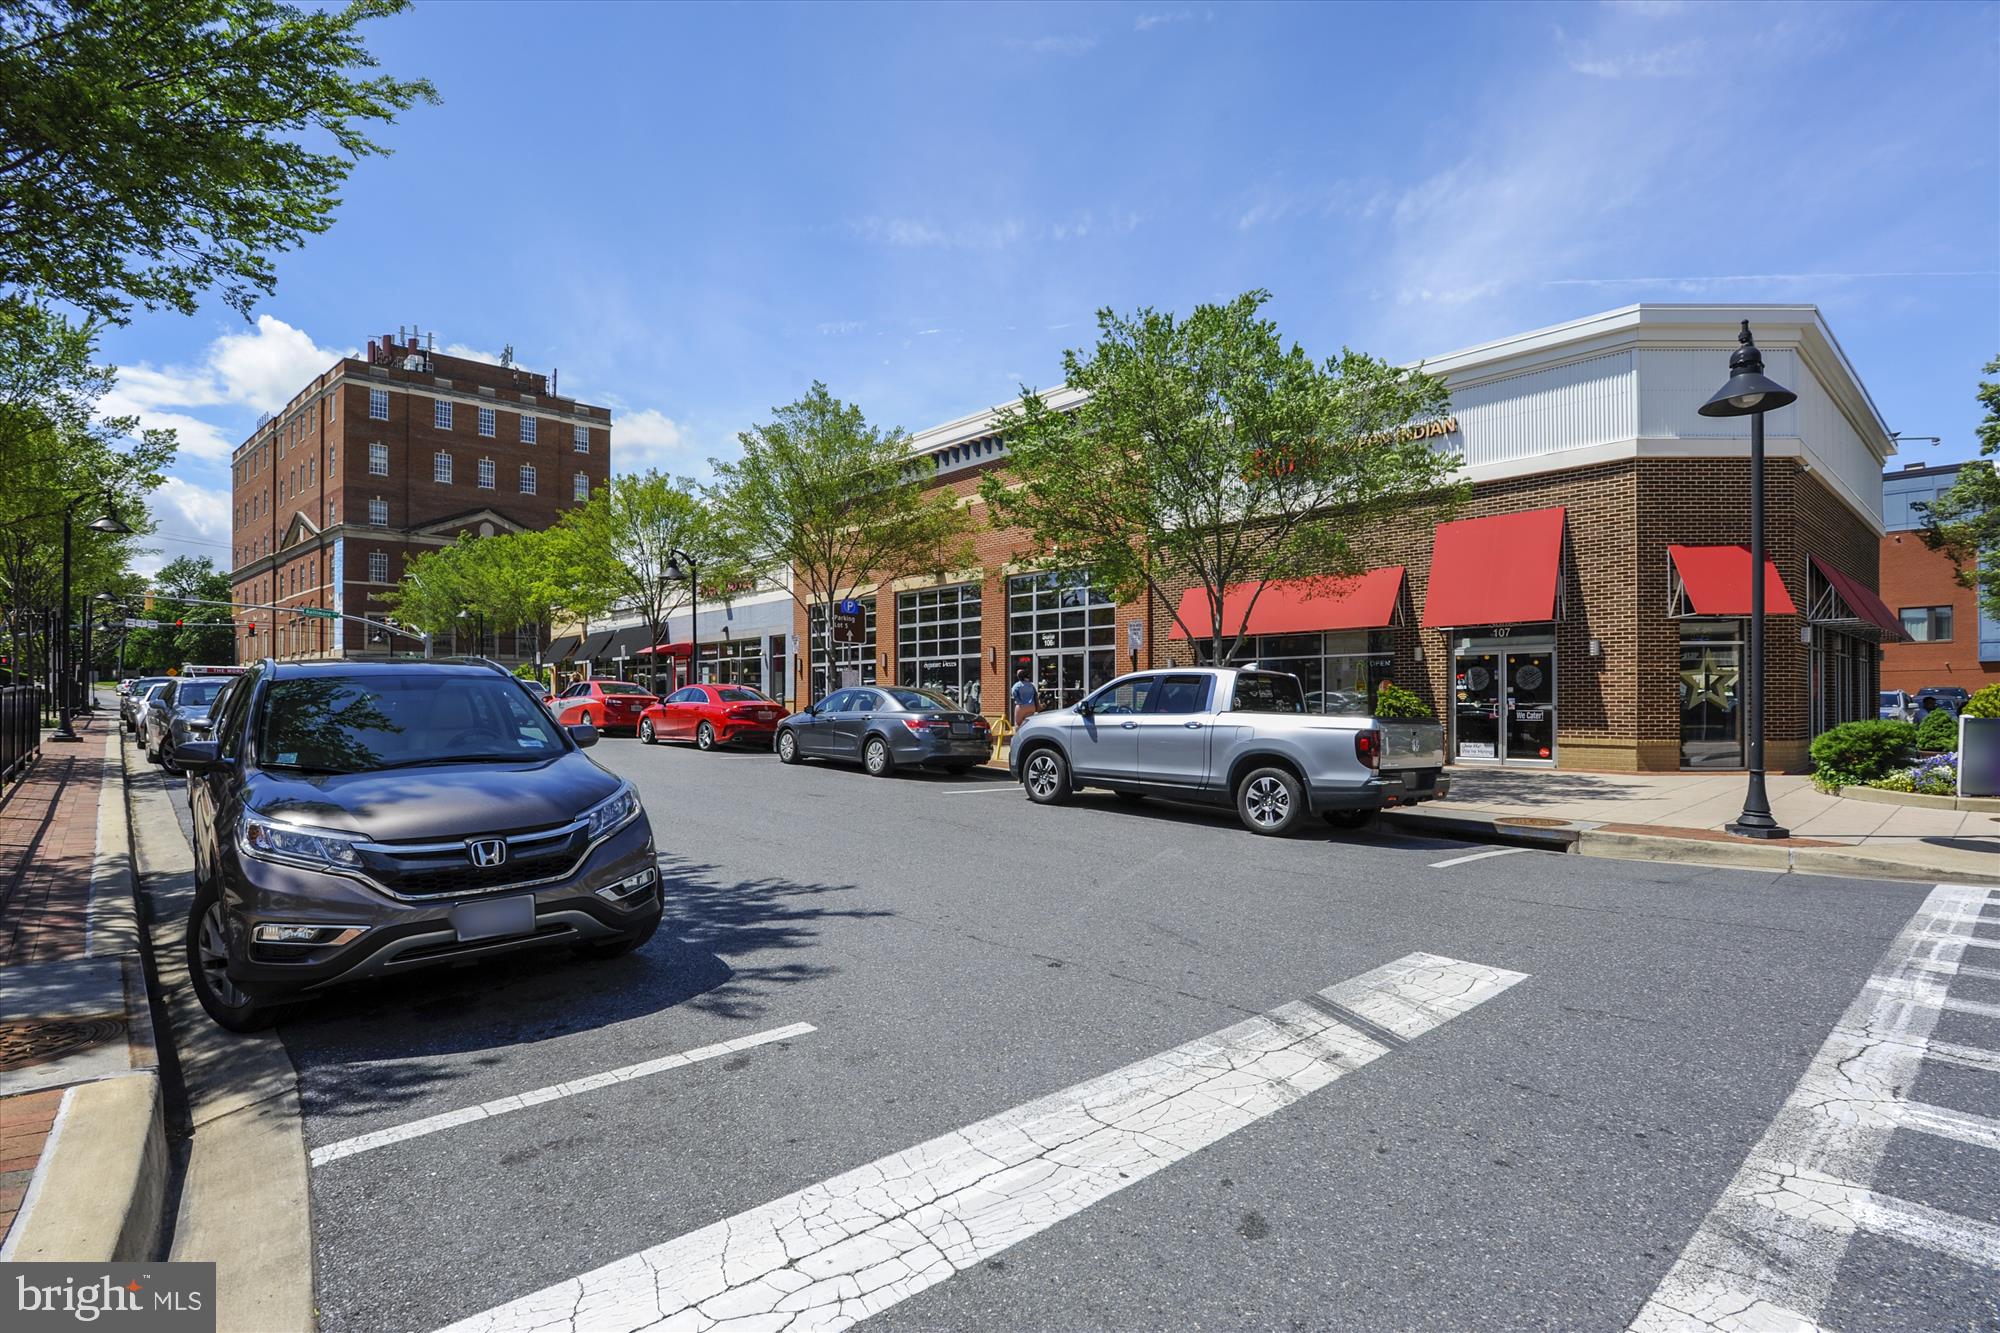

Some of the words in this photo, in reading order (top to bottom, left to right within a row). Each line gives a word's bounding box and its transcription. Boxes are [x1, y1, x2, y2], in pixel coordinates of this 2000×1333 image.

[1396, 417, 1457, 443] INDIAN
[305, 609, 331, 617] Baltimore
[834, 615, 855, 623] Parking
[1493, 627, 1511, 638] 107
[1516, 711, 1526, 719] We
